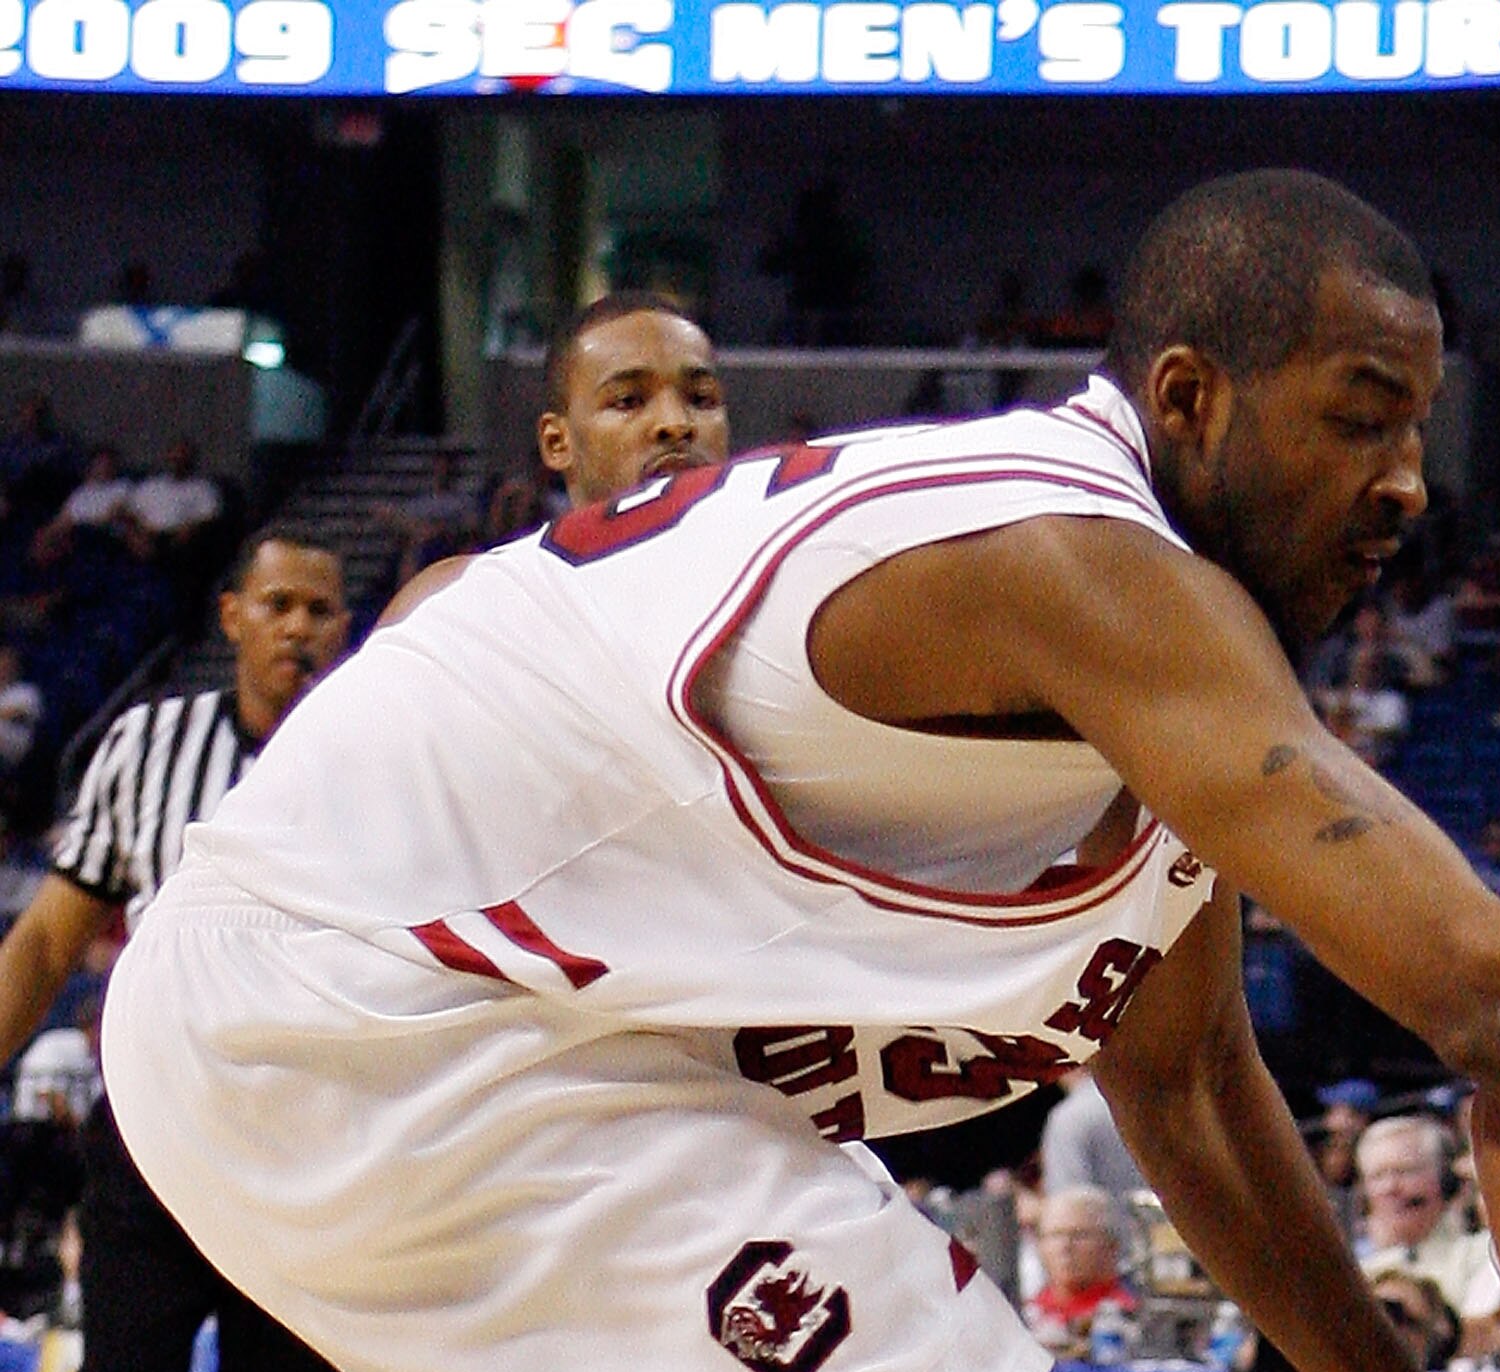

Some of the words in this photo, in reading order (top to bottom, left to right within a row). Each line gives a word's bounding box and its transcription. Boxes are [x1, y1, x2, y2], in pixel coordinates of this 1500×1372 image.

[0, 0, 335, 85] 009
[383, 0, 674, 94] SEC
[709, 0, 1125, 83] MEN'S
